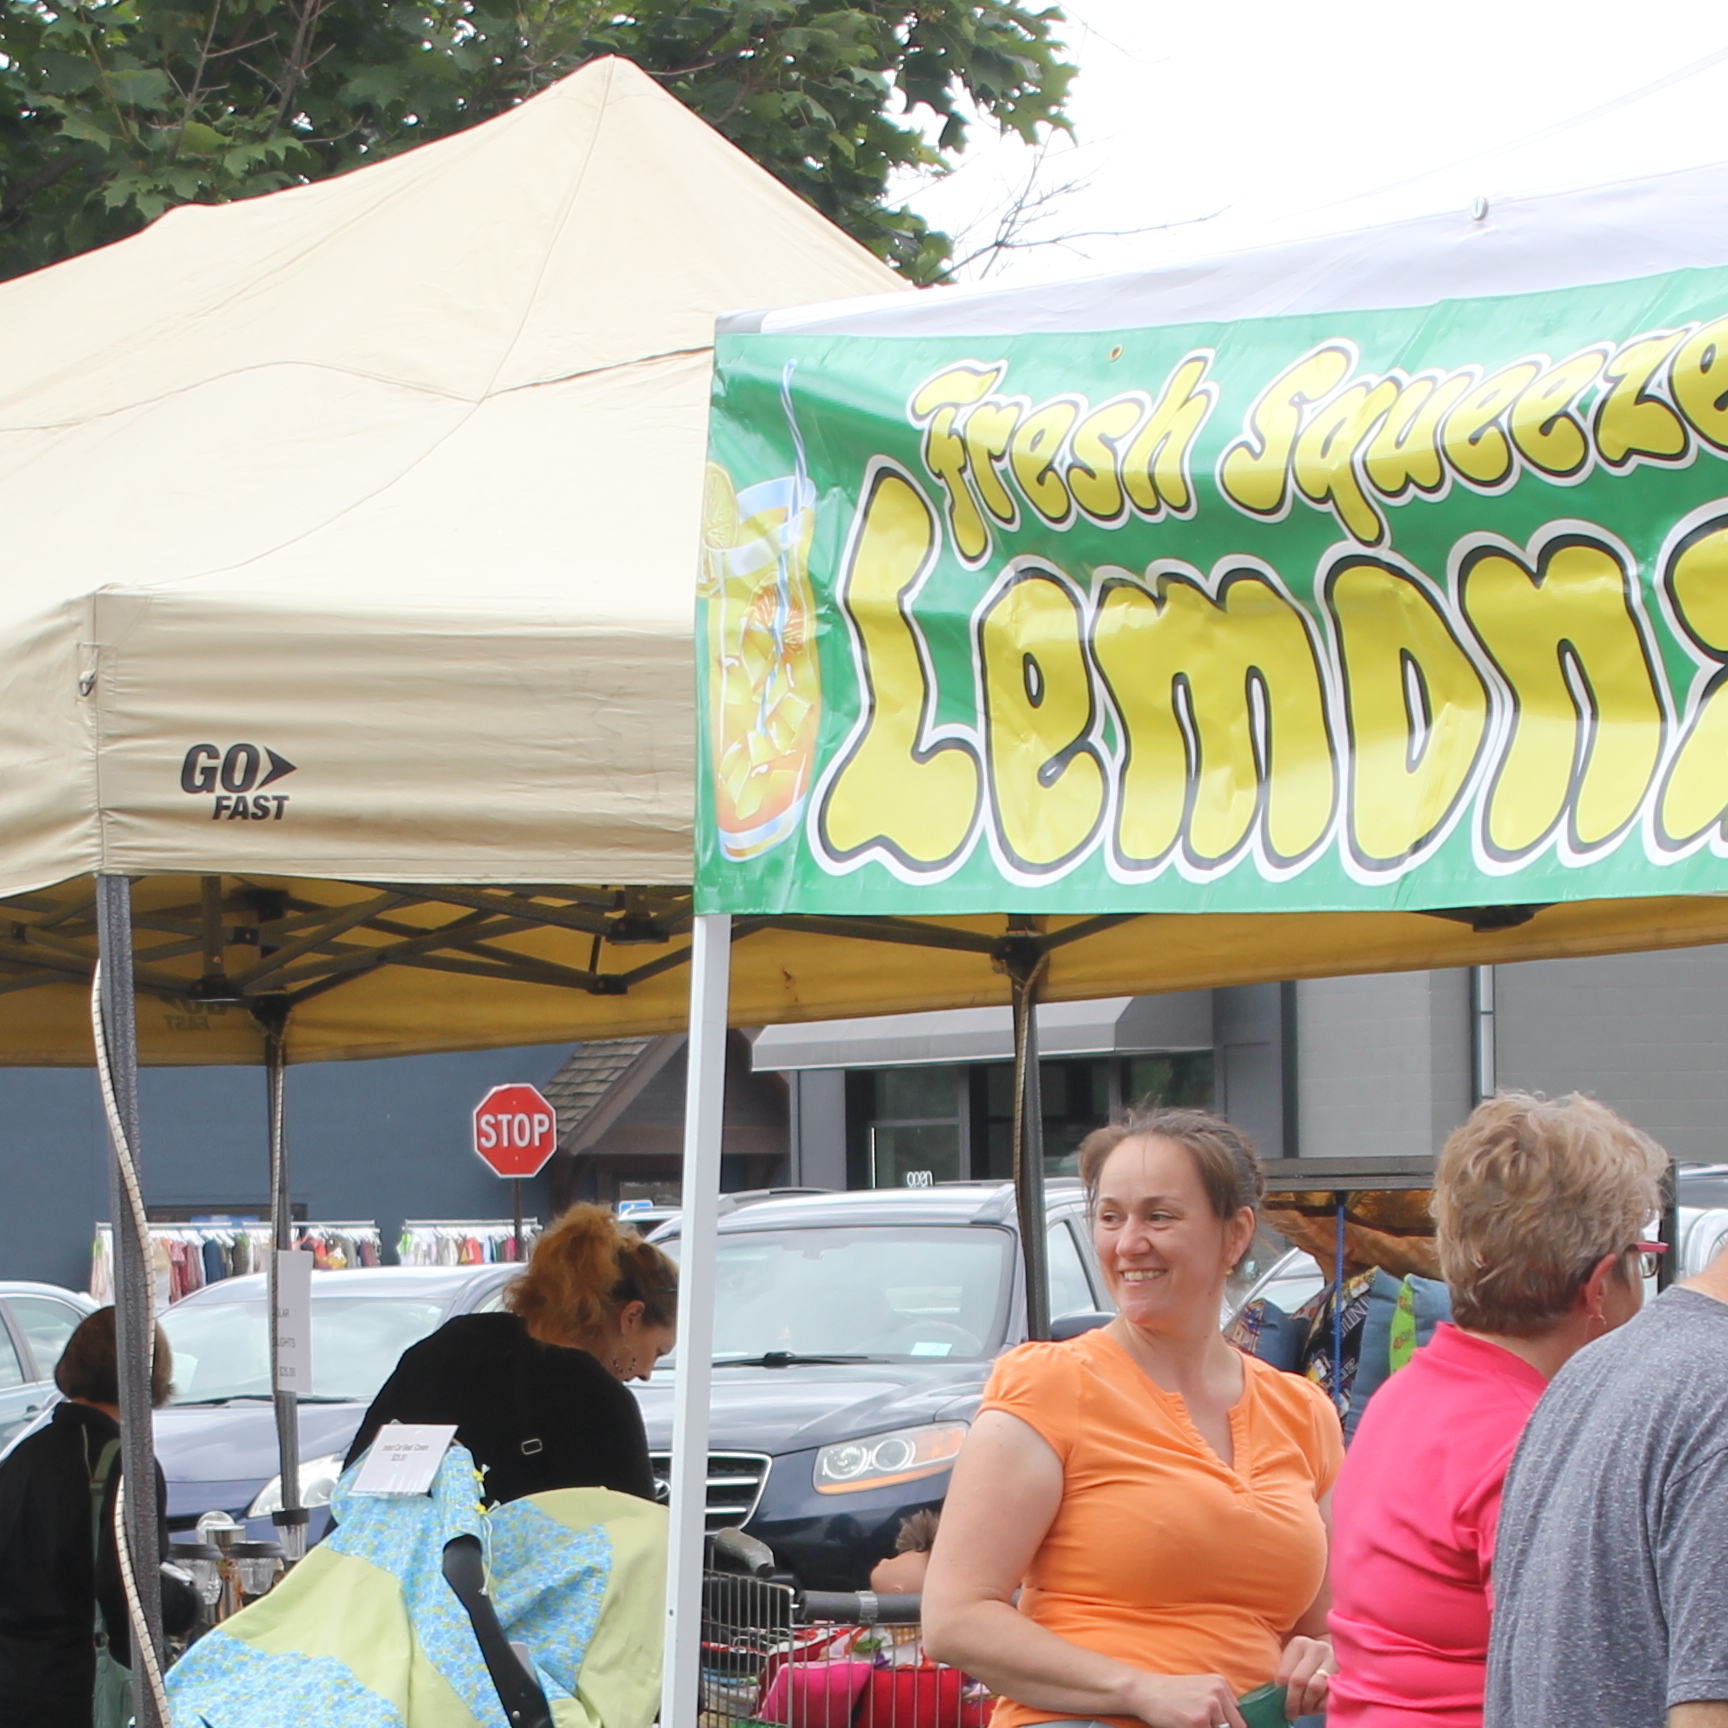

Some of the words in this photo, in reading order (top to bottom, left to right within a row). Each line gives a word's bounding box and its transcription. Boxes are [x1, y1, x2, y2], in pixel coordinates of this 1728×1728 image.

[910, 348, 1219, 570] Fresh
[180, 743, 261, 793] GO
[212, 794, 291, 820] FAST
[479, 1113, 550, 1149] STOP
